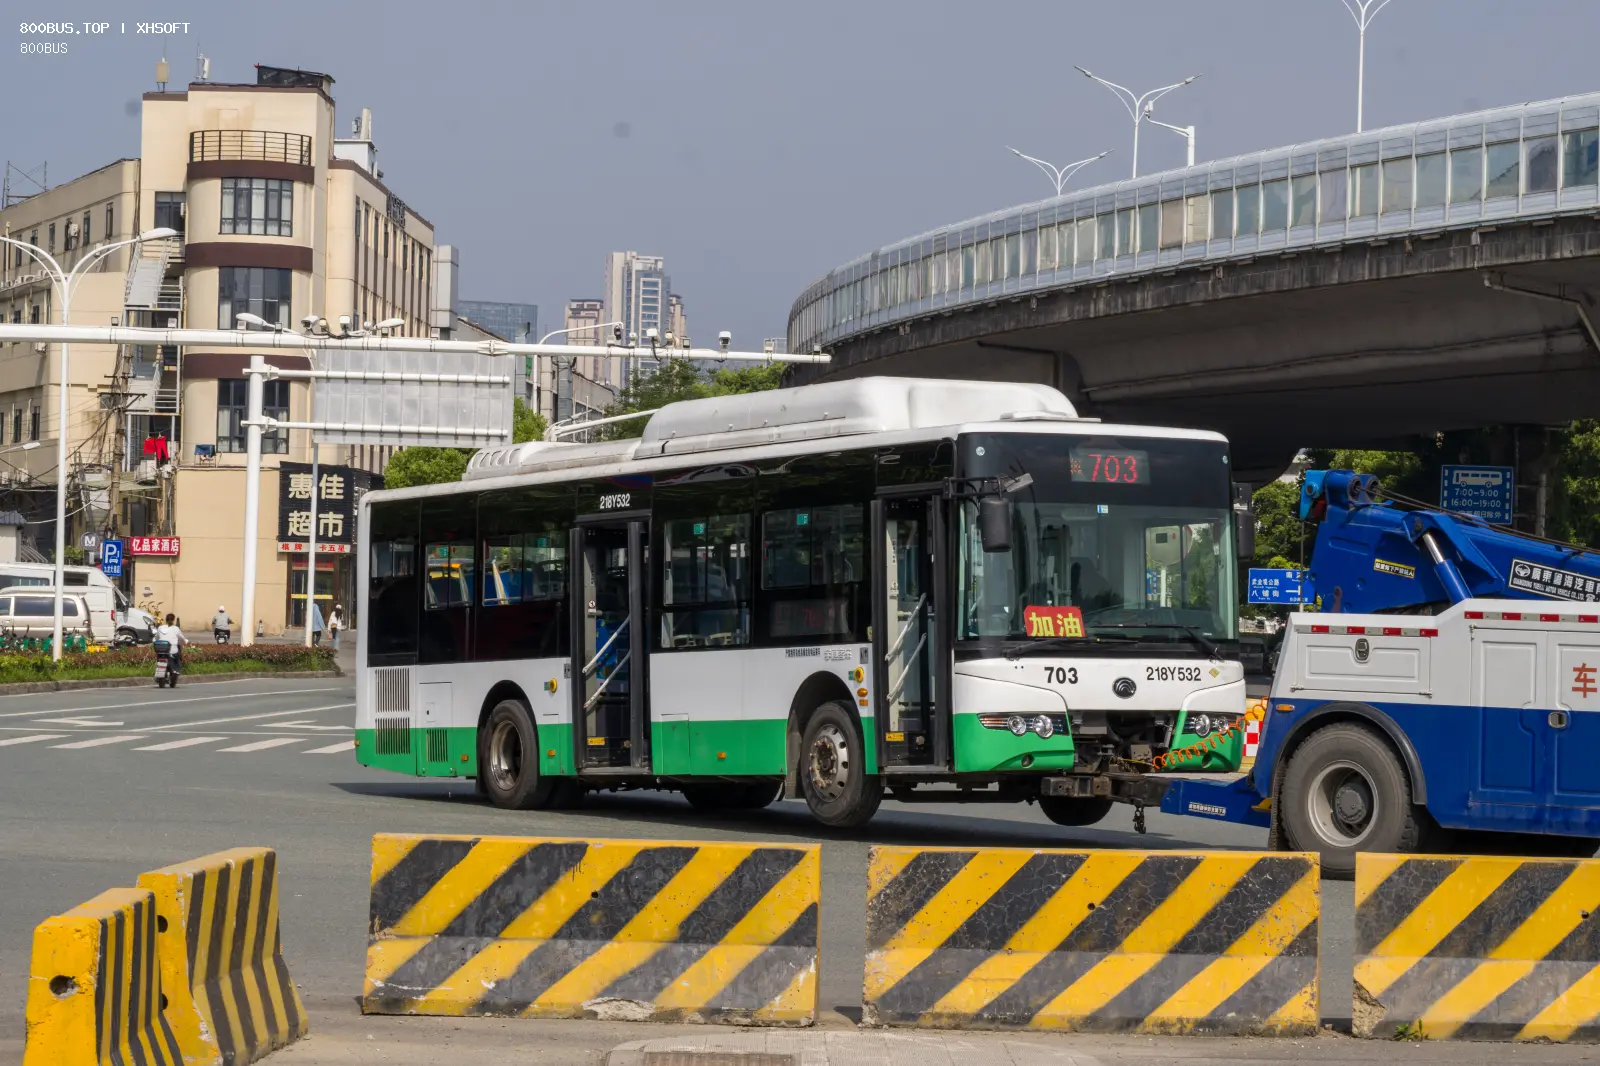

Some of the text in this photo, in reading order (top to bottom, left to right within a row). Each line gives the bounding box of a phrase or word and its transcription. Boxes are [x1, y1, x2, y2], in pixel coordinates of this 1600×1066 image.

[1087, 453, 1138, 483] 703
[288, 473, 344, 499] 惠佳
[599, 493, 631, 509] 218Y532
[288, 510, 344, 538] 超市
[104, 543, 117, 564] P
[131, 538, 180, 552] 亿品家酒店
[1029, 612, 1083, 637] 加油
[1044, 666, 1079, 685] 703
[1146, 666, 1202, 682] 218Y532
